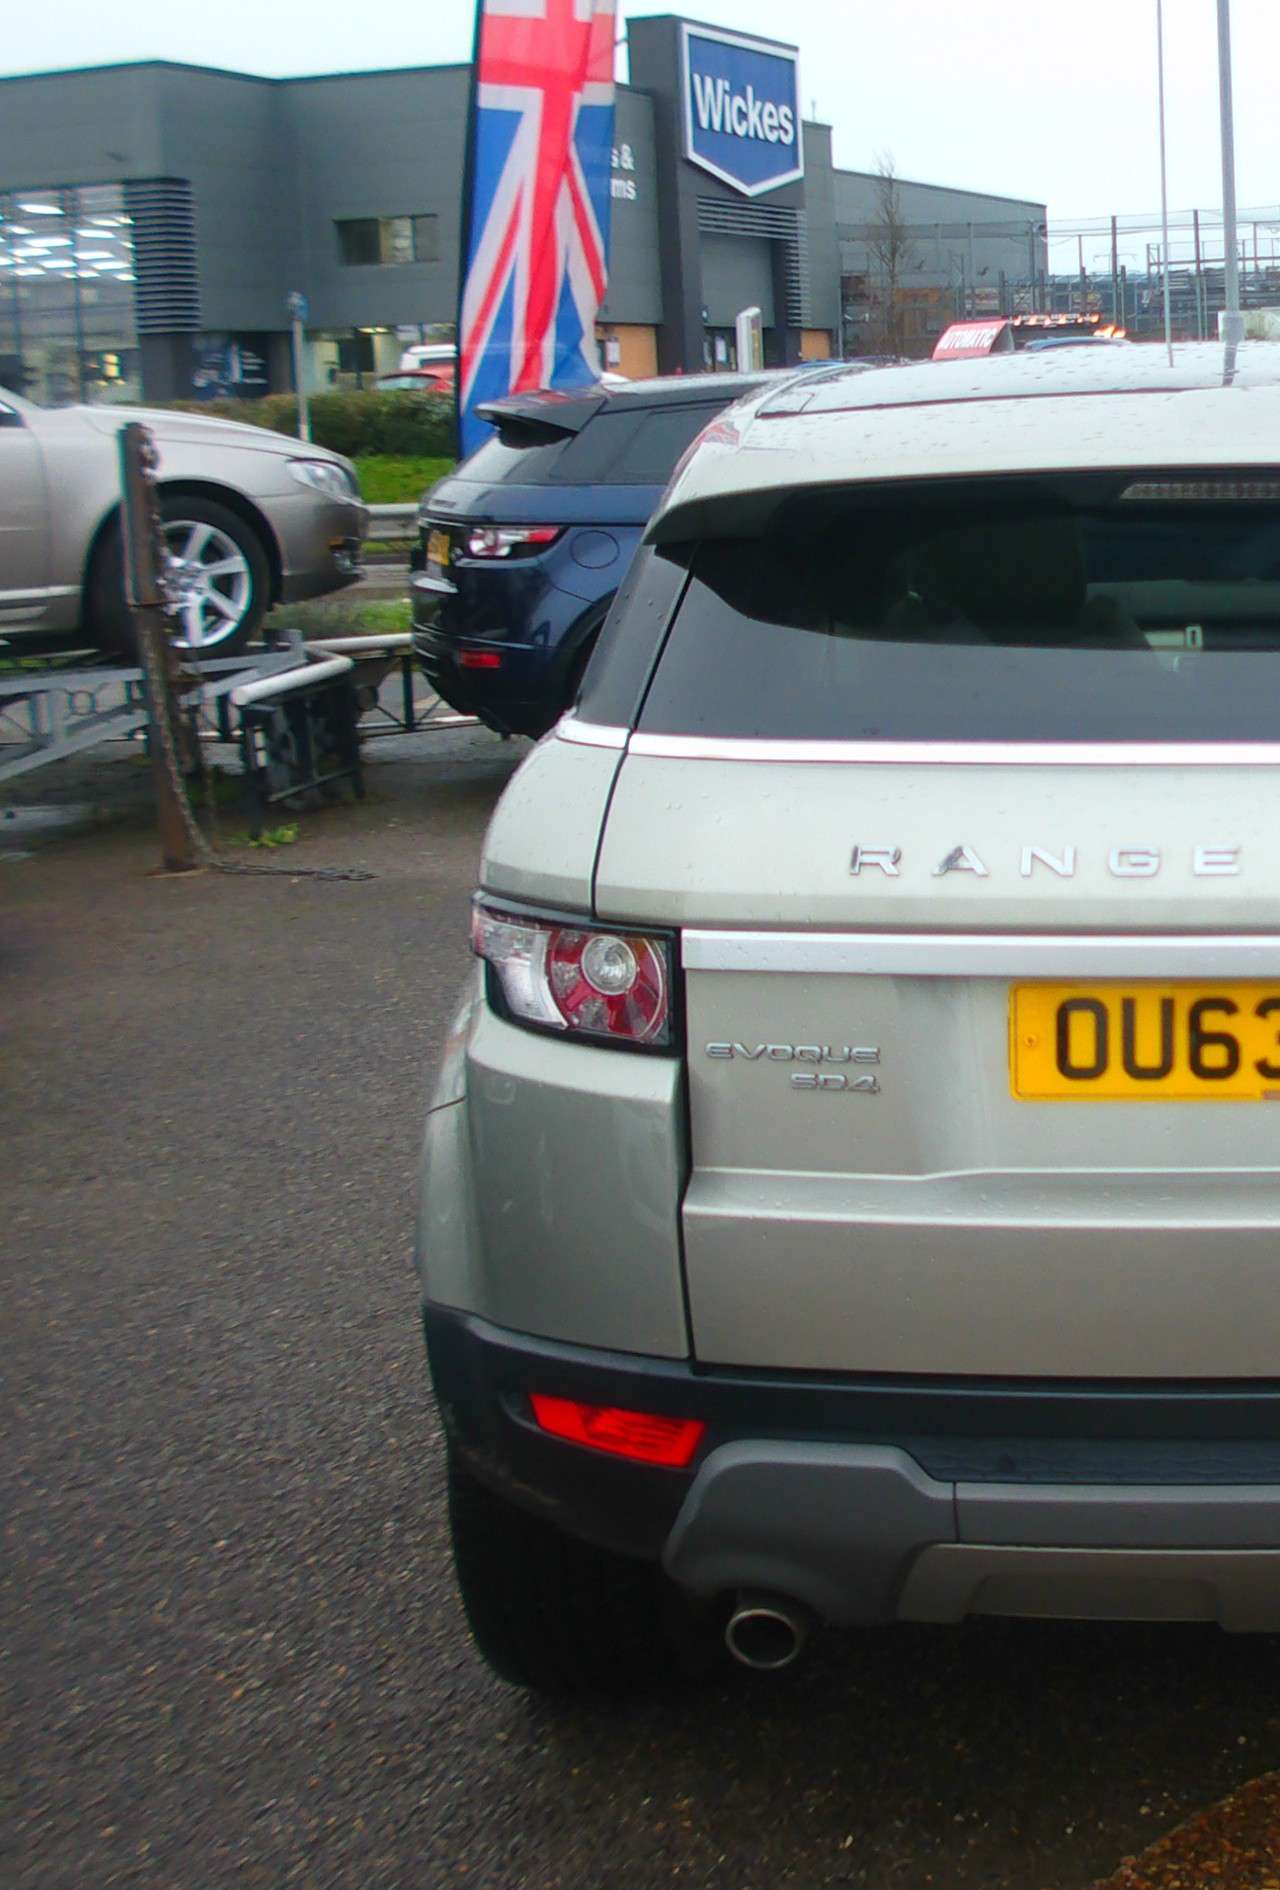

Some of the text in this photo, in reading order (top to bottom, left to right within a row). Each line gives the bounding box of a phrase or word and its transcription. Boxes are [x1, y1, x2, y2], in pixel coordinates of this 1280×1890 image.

[692, 72, 796, 145] Wickes
[849, 843, 1241, 878] RANGE
[705, 1042, 881, 1065] EVOQUE
[790, 1073, 881, 1094] SD4
